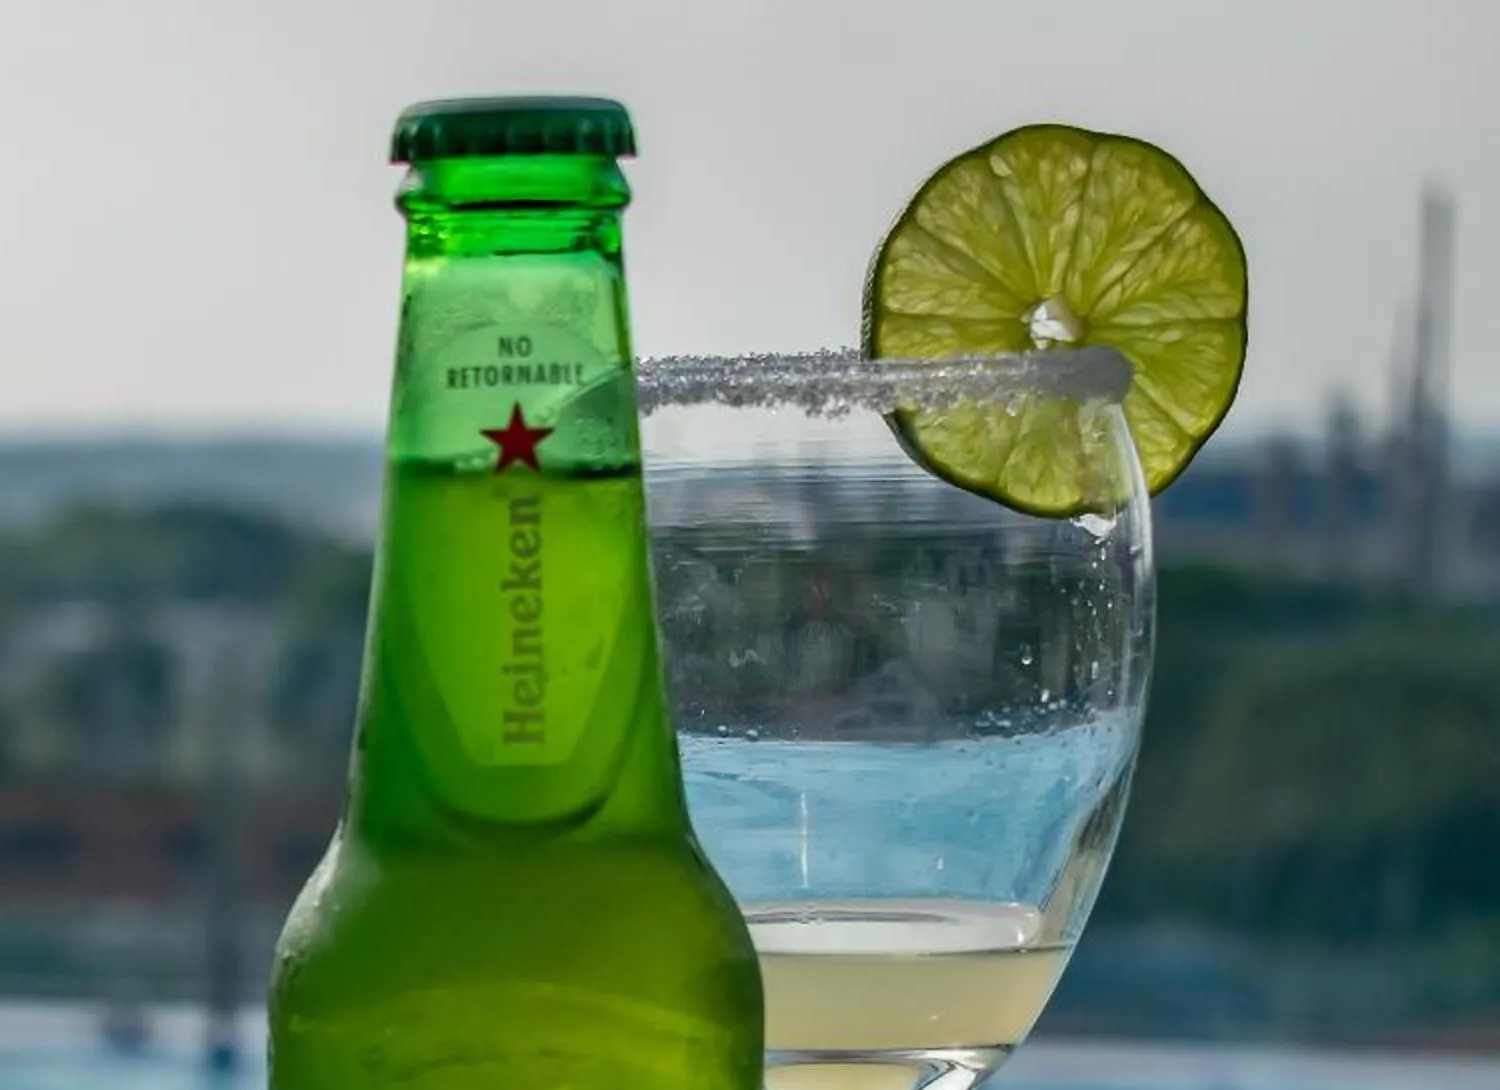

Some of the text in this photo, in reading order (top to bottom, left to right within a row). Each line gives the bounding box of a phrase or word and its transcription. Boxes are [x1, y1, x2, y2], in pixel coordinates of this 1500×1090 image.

[498, 335, 533, 358] NO
[445, 363, 585, 389] RETORNABLE
[501, 494, 546, 745] Heineken
